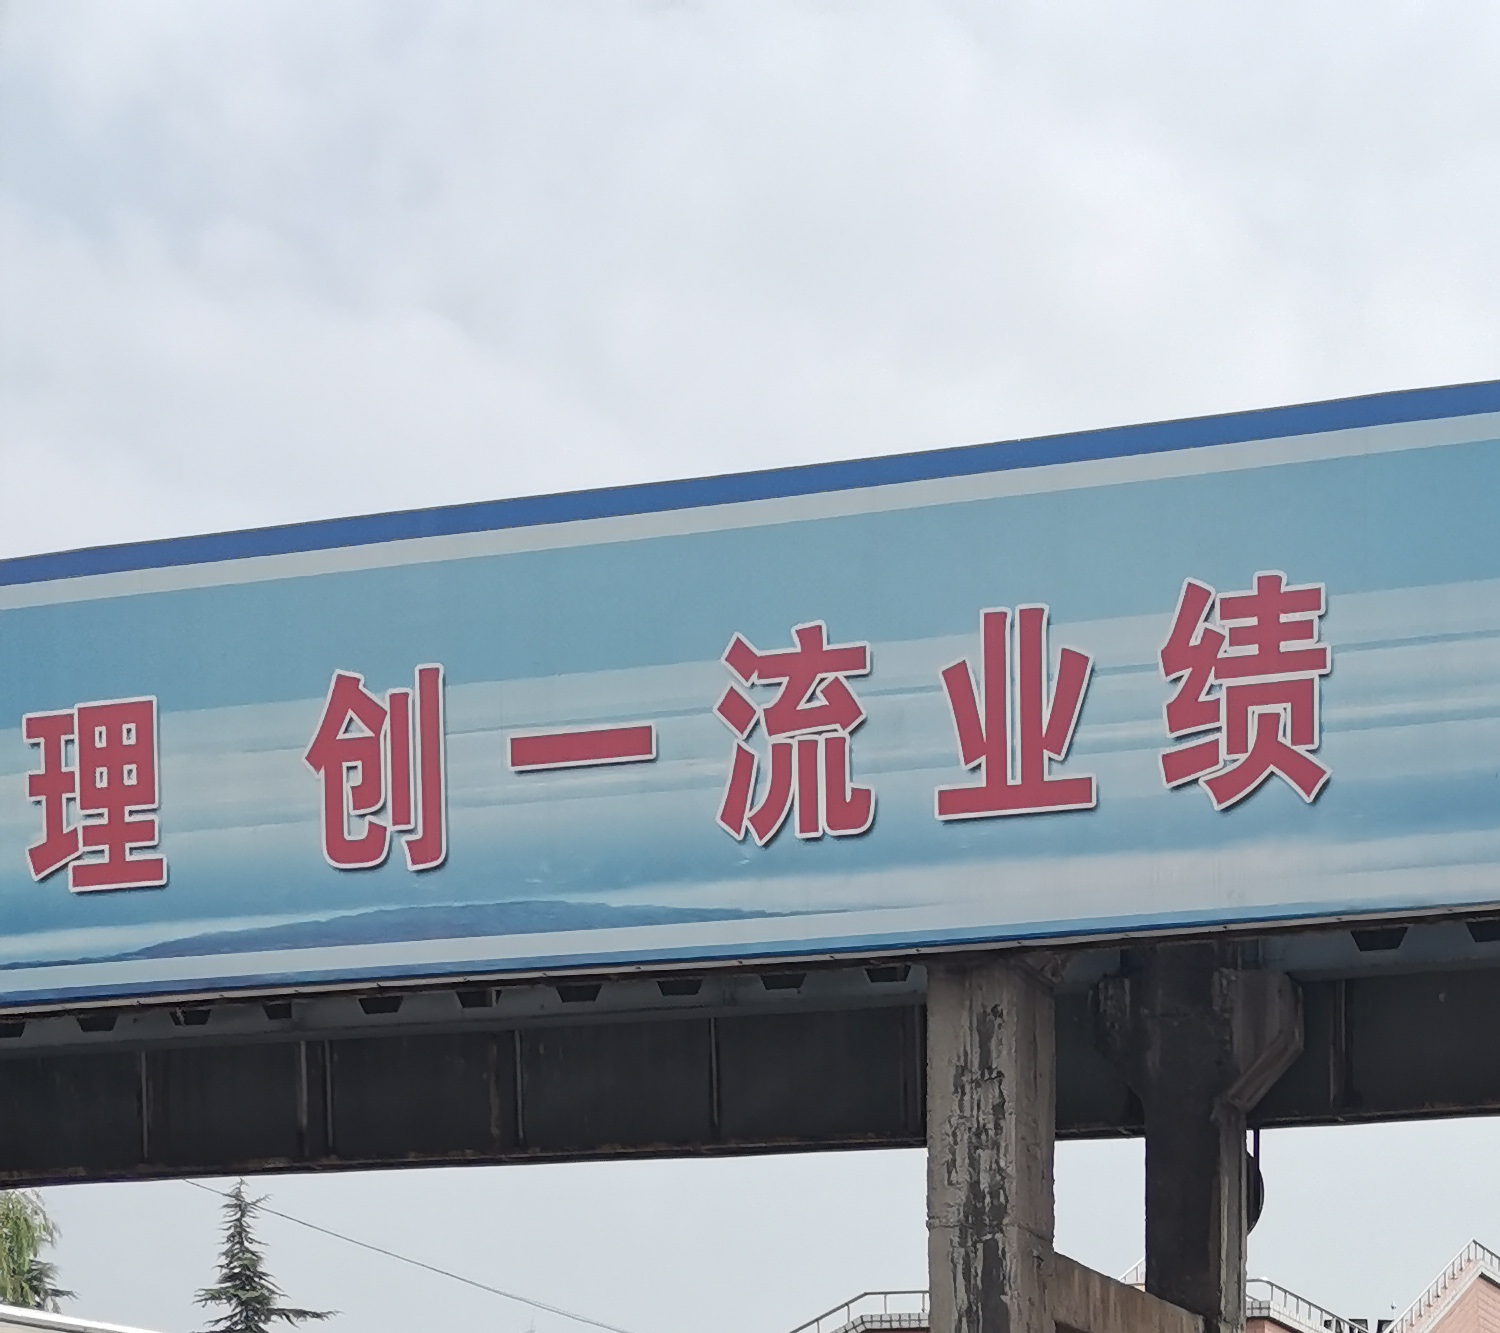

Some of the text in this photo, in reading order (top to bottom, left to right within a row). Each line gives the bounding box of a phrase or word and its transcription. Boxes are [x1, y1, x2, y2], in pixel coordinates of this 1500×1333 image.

[22, 694, 168, 893] 理
[301, 569, 1334, 872] 创一流业绩
